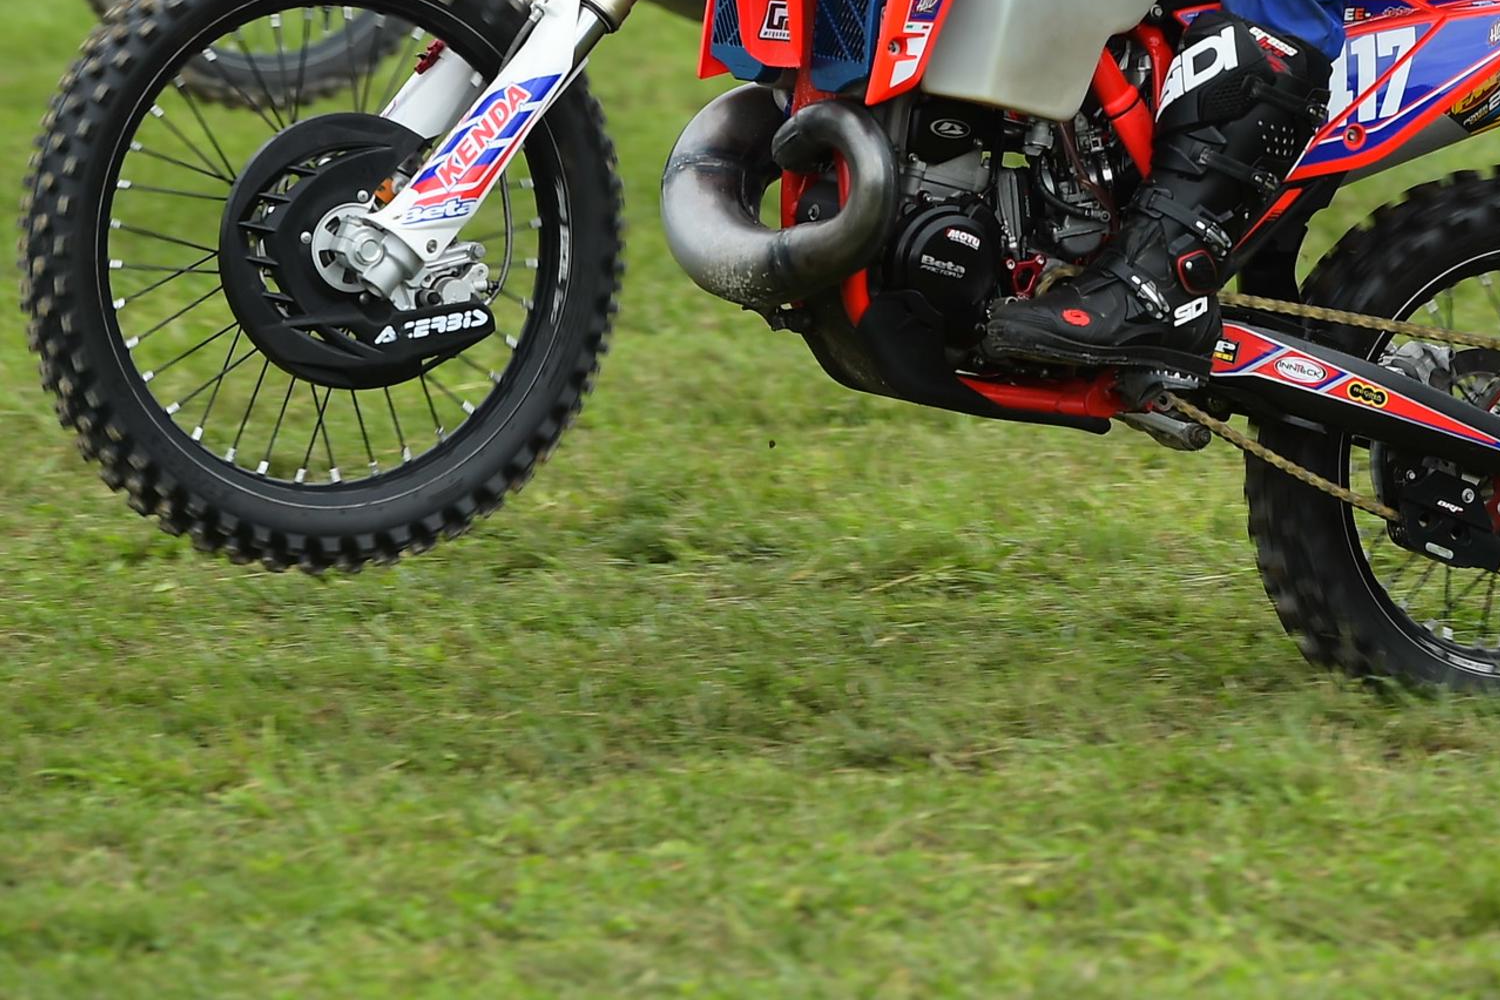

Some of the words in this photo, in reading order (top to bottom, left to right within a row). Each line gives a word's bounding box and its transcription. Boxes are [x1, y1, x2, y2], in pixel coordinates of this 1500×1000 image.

[437, 85, 529, 186] KENDA
[402, 198, 478, 224] Beta
[948, 229, 980, 246] MOTU
[921, 254, 966, 273] Beta
[375, 309, 488, 344] ACERBIS
